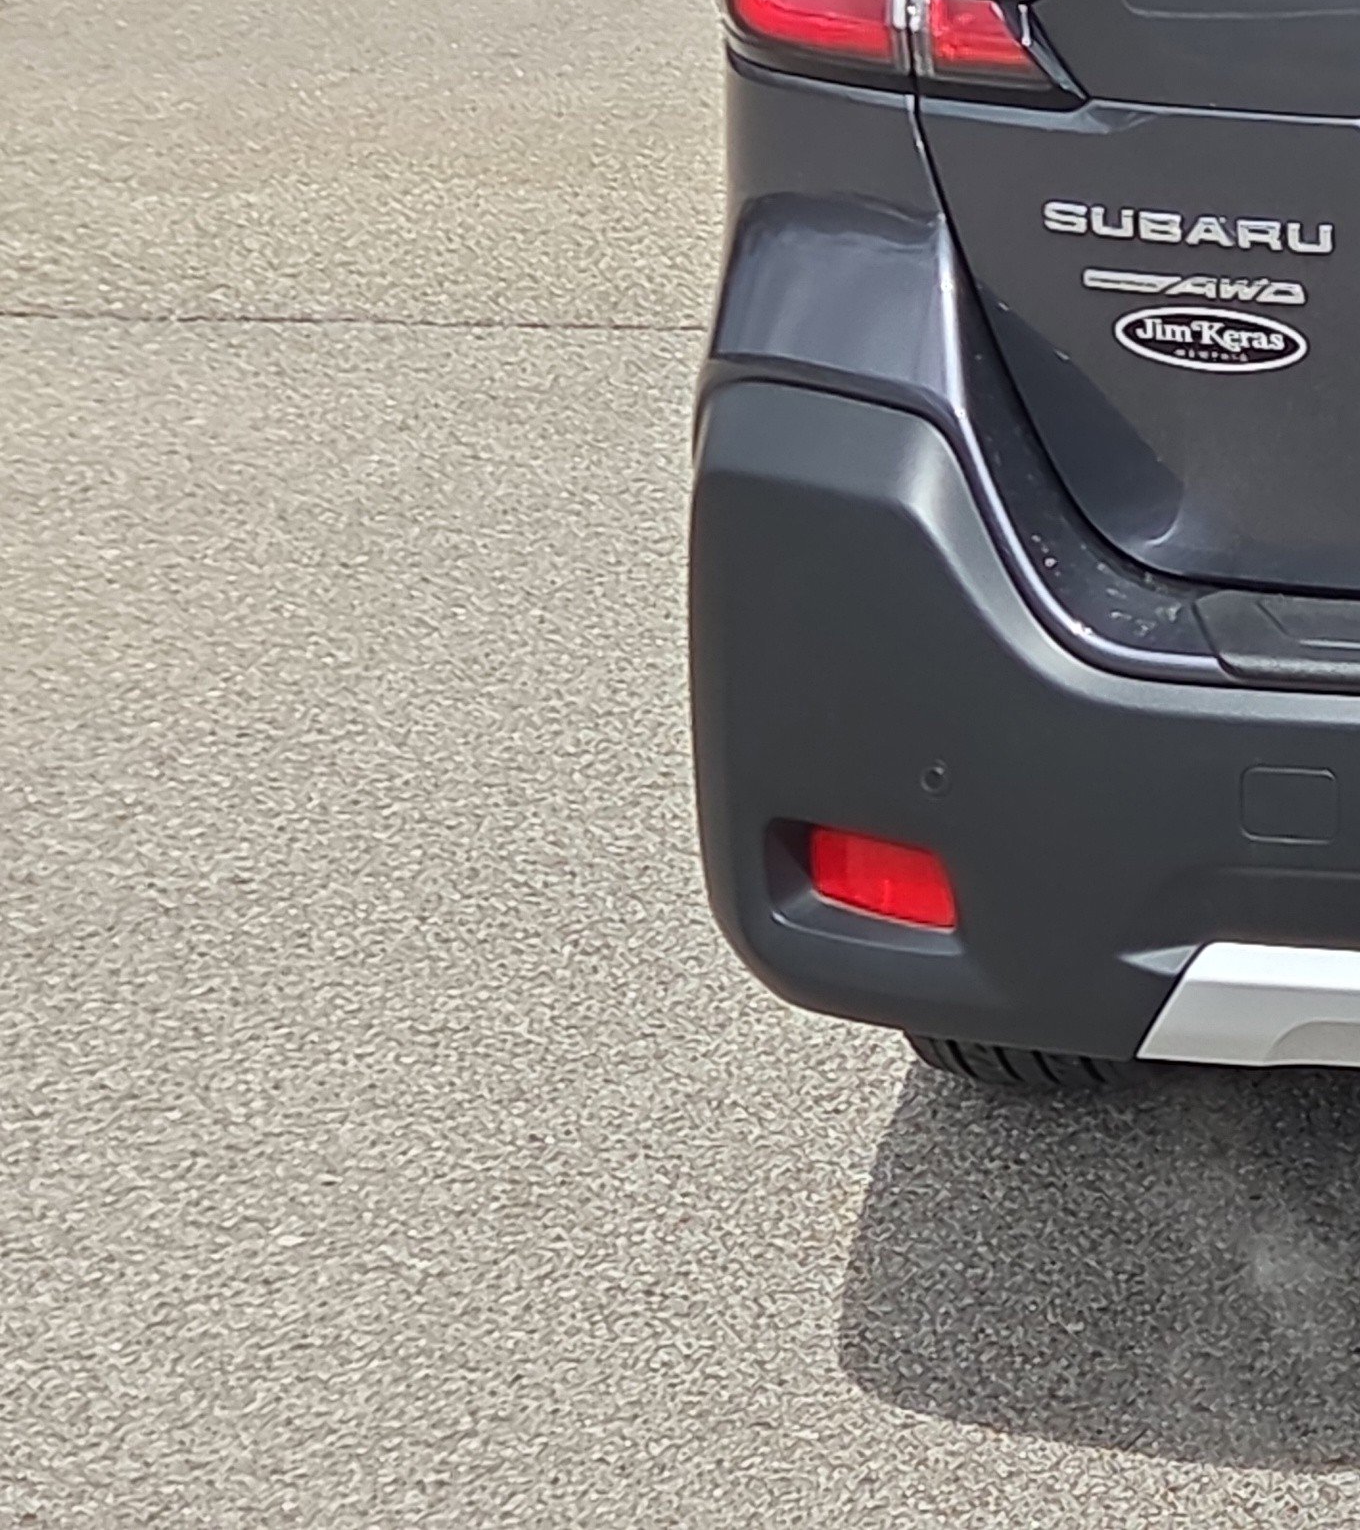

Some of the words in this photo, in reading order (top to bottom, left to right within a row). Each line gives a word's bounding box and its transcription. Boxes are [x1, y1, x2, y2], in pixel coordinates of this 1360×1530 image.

[1043, 201, 1334, 254] SUBARU
[1166, 275, 1306, 305] AWD
[1135, 318, 1193, 343] Jim
[1190, 320, 1286, 352] Keras
